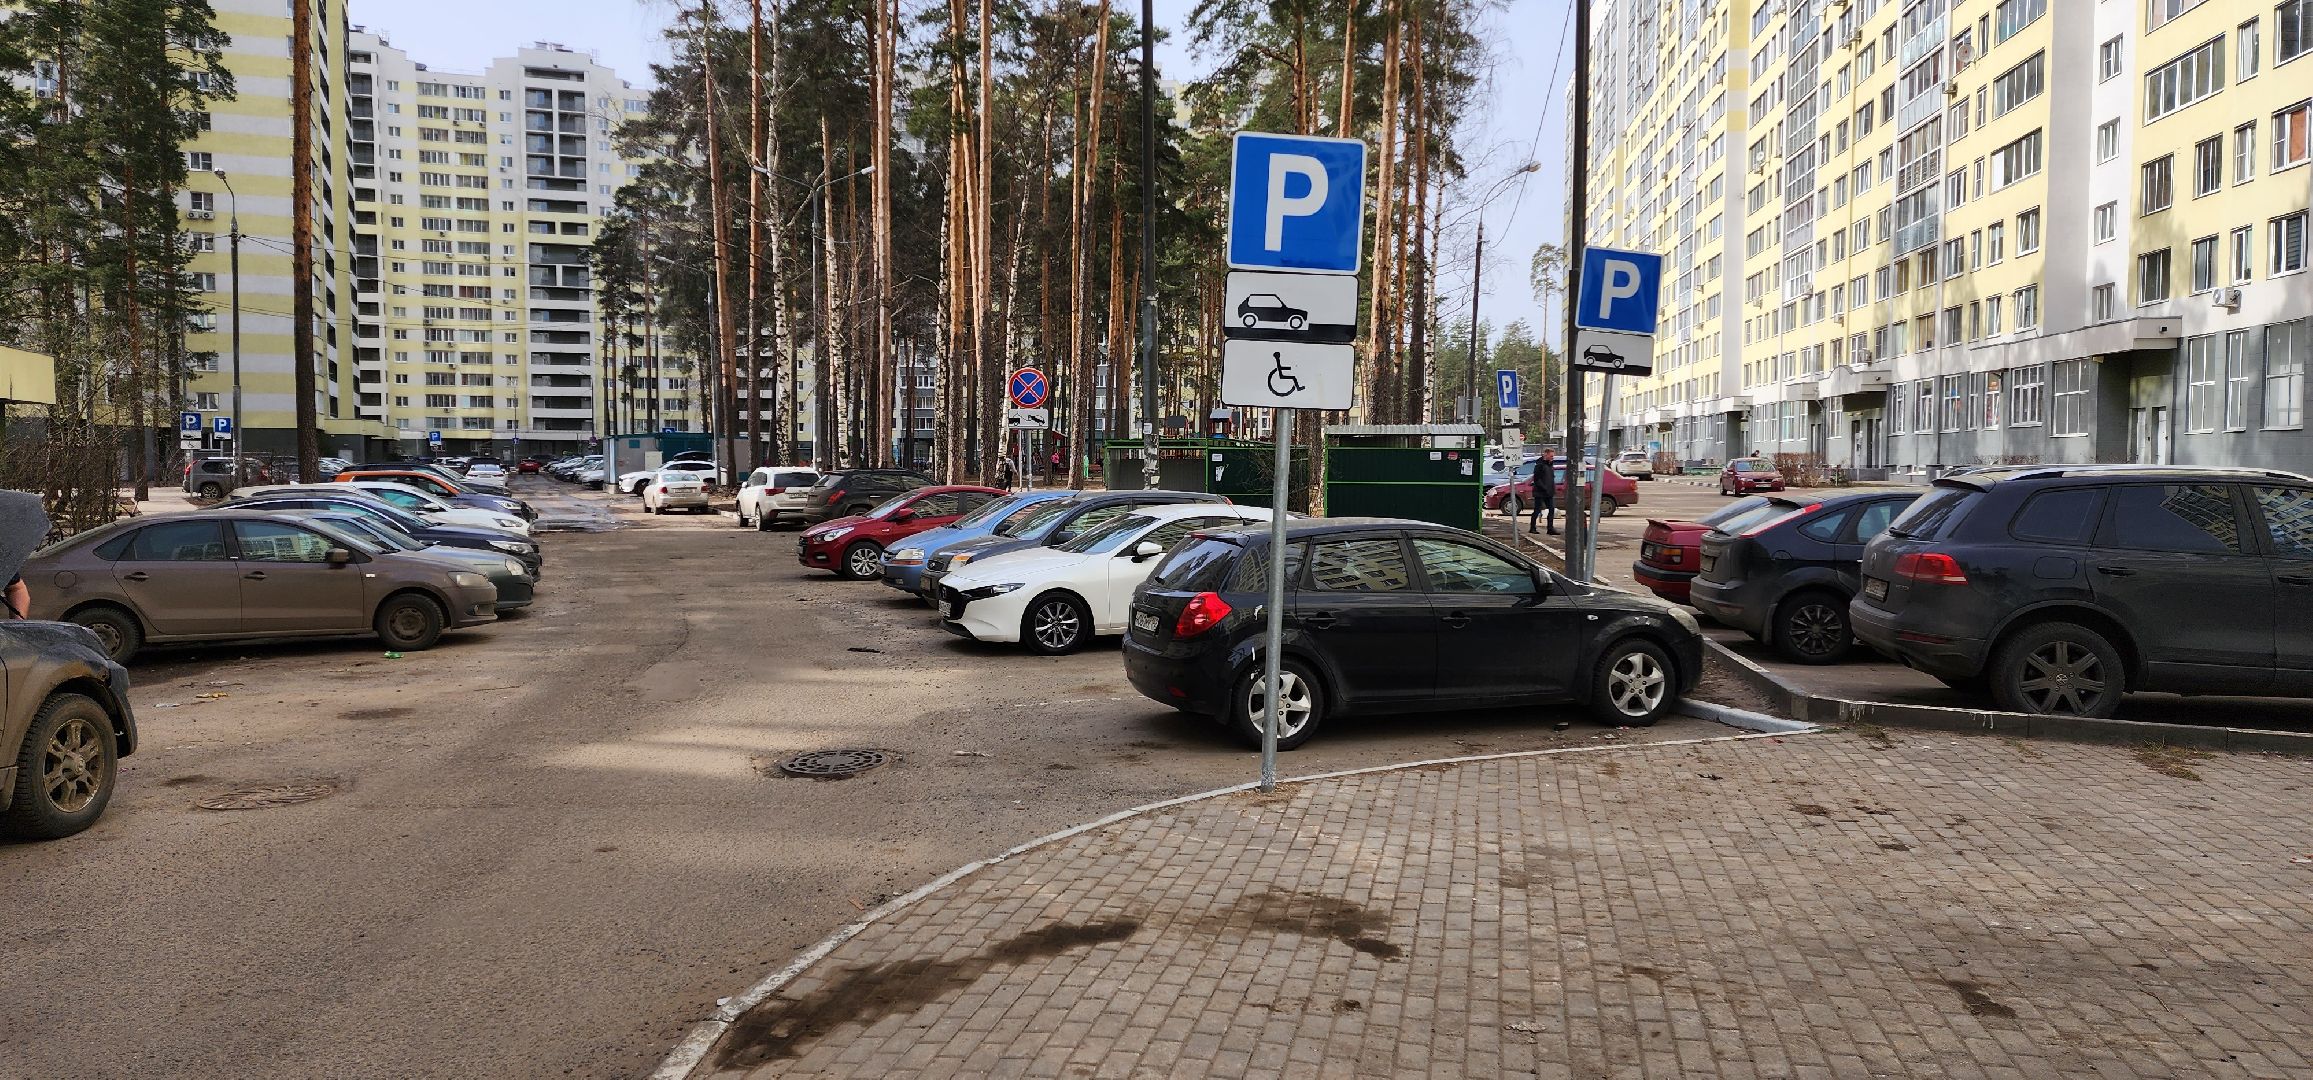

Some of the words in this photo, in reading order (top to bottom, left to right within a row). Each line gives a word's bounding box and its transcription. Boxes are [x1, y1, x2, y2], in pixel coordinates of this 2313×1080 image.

[1264, 152, 1329, 252] P
[1598, 258, 1641, 320] P
[1501, 375, 1513, 404] P
[185, 415, 196, 429] P
[218, 418, 227, 431] P
[431, 432, 438, 440] P
